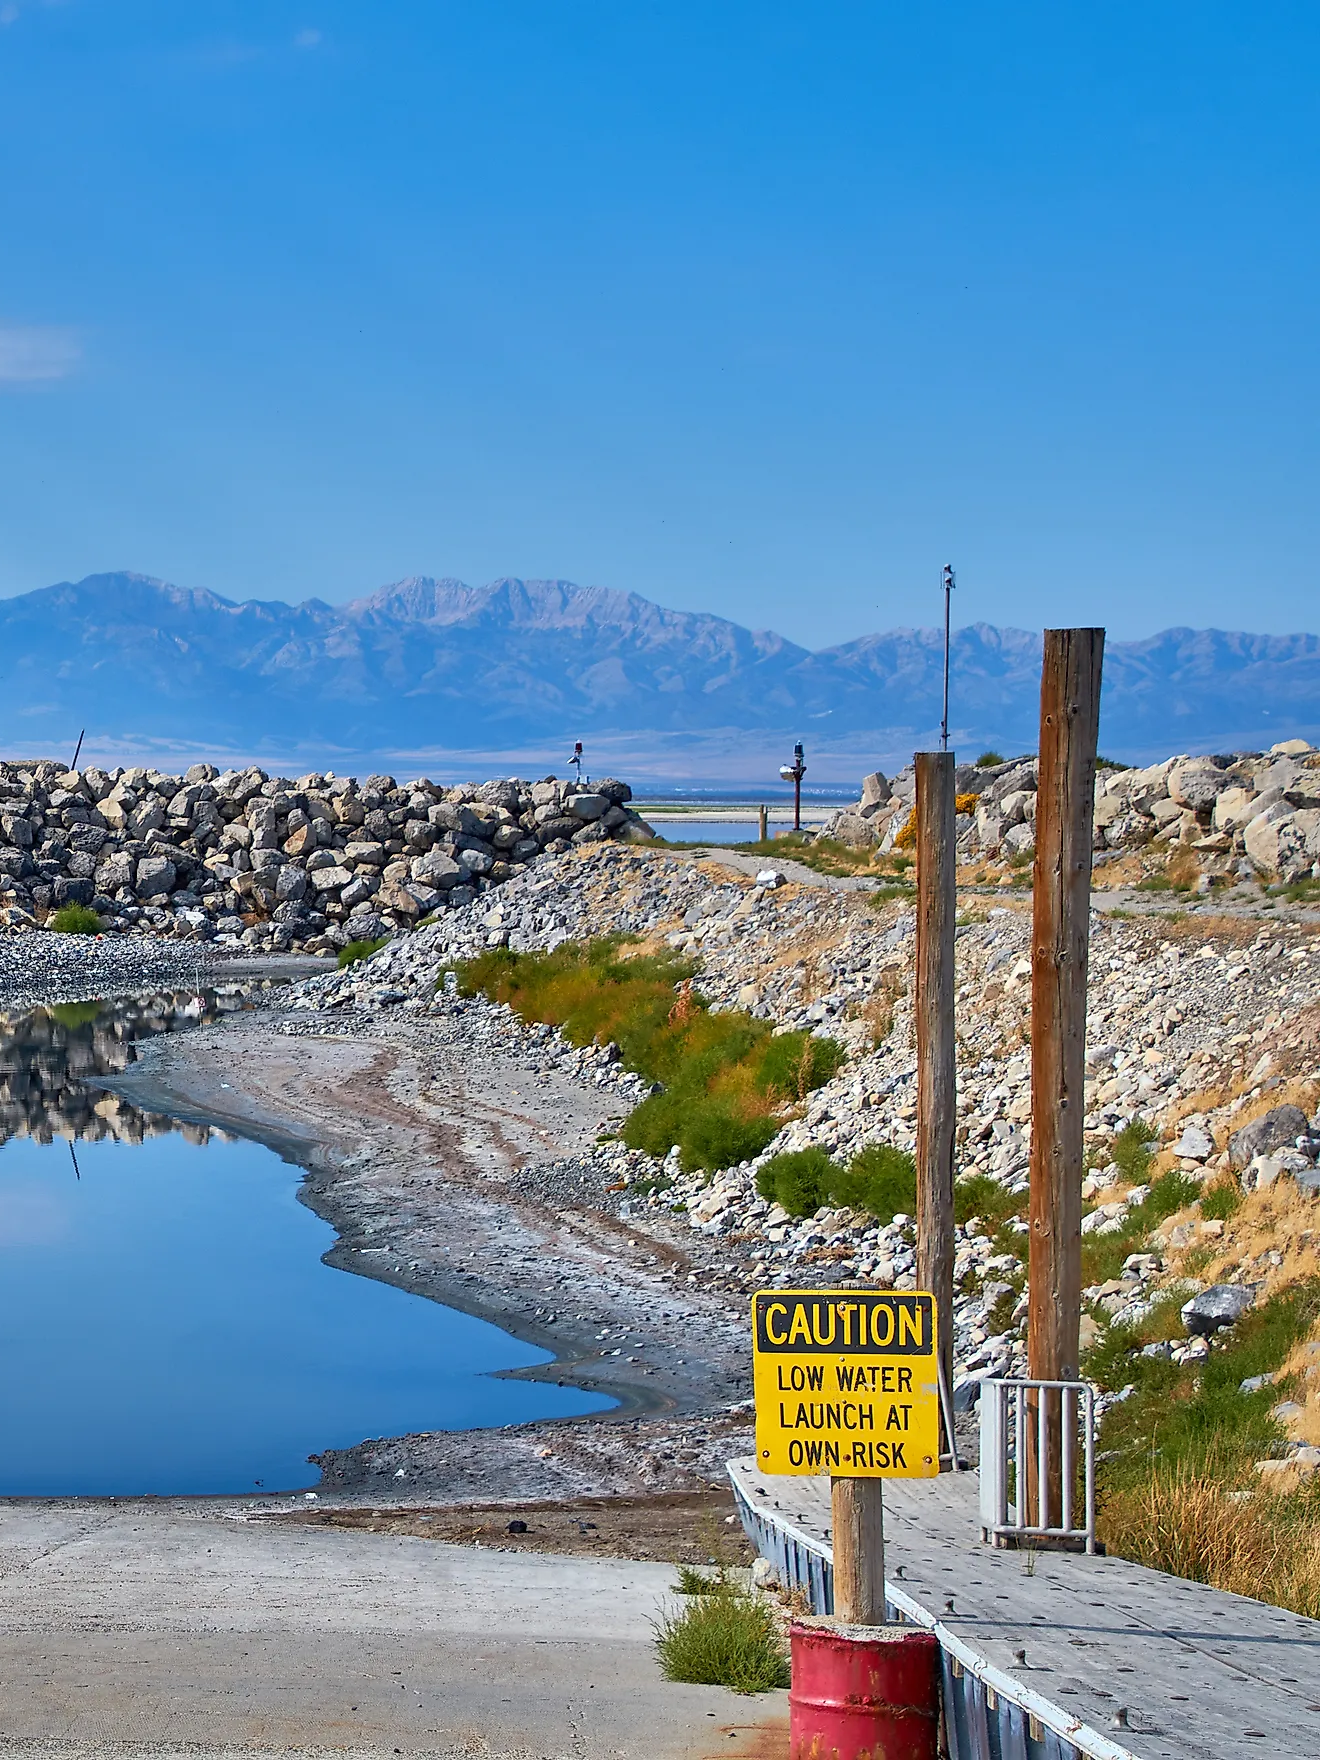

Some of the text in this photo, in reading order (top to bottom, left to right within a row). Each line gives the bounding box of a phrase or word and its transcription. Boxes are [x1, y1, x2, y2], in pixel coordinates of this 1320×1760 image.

[765, 1303, 923, 1347] CAUTION
[777, 1365, 913, 1393] LOW WATER
[779, 1403, 913, 1431] LAUNCH AT
[788, 1440, 907, 1469] OWN RISK
